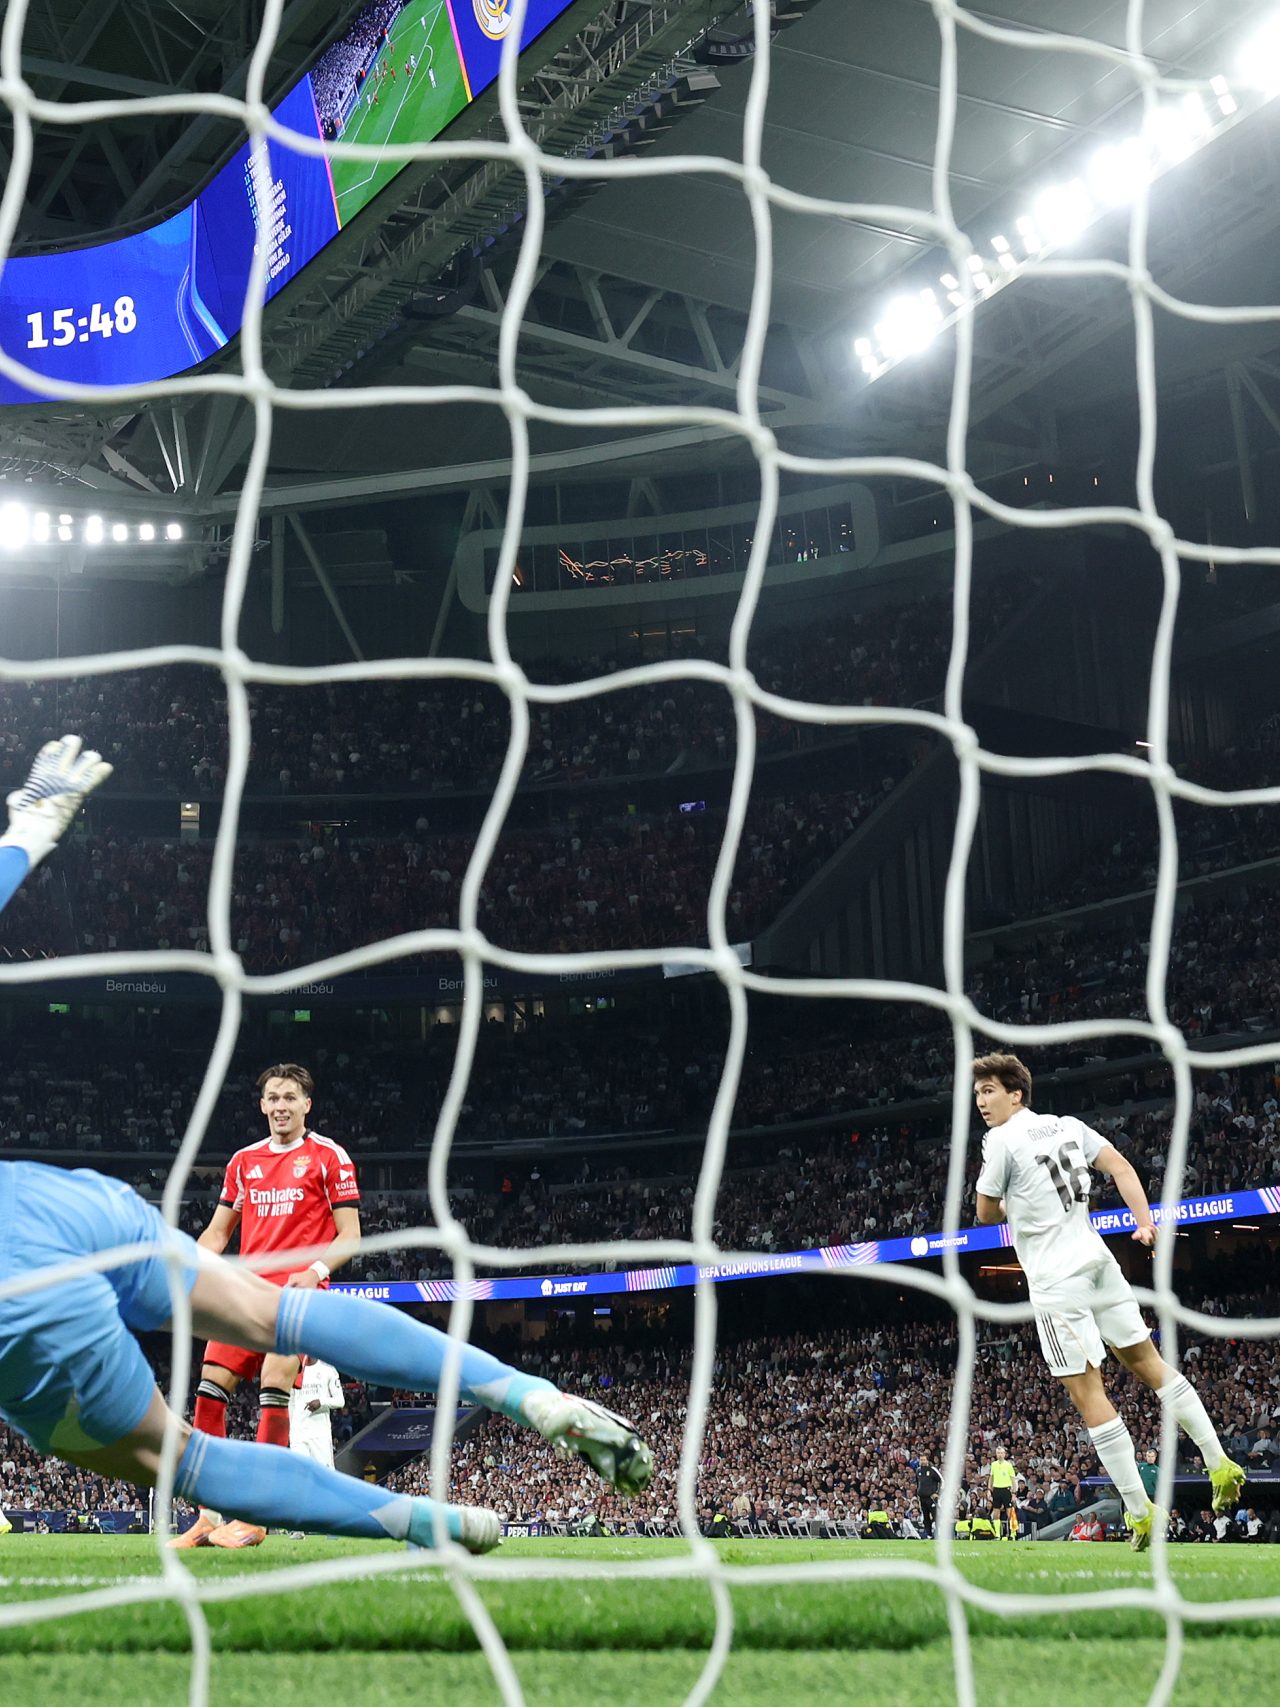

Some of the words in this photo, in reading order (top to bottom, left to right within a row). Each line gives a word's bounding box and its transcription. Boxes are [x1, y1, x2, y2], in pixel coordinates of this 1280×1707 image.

[26, 295, 137, 349] 15:48
[106, 979, 167, 994] Bernabéu
[439, 975, 498, 990] Bernéu
[1034, 1140, 1092, 1212] 16
[250, 1187, 304, 1204] Emirates
[1093, 1214, 1121, 1230] UEFA
[1189, 1199, 1234, 1218] LEAGUE
[720, 1260, 769, 1277] CHAMPIONS
[770, 1255, 802, 1271] LEAGUE
[507, 1526, 529, 1537] PEPSI
